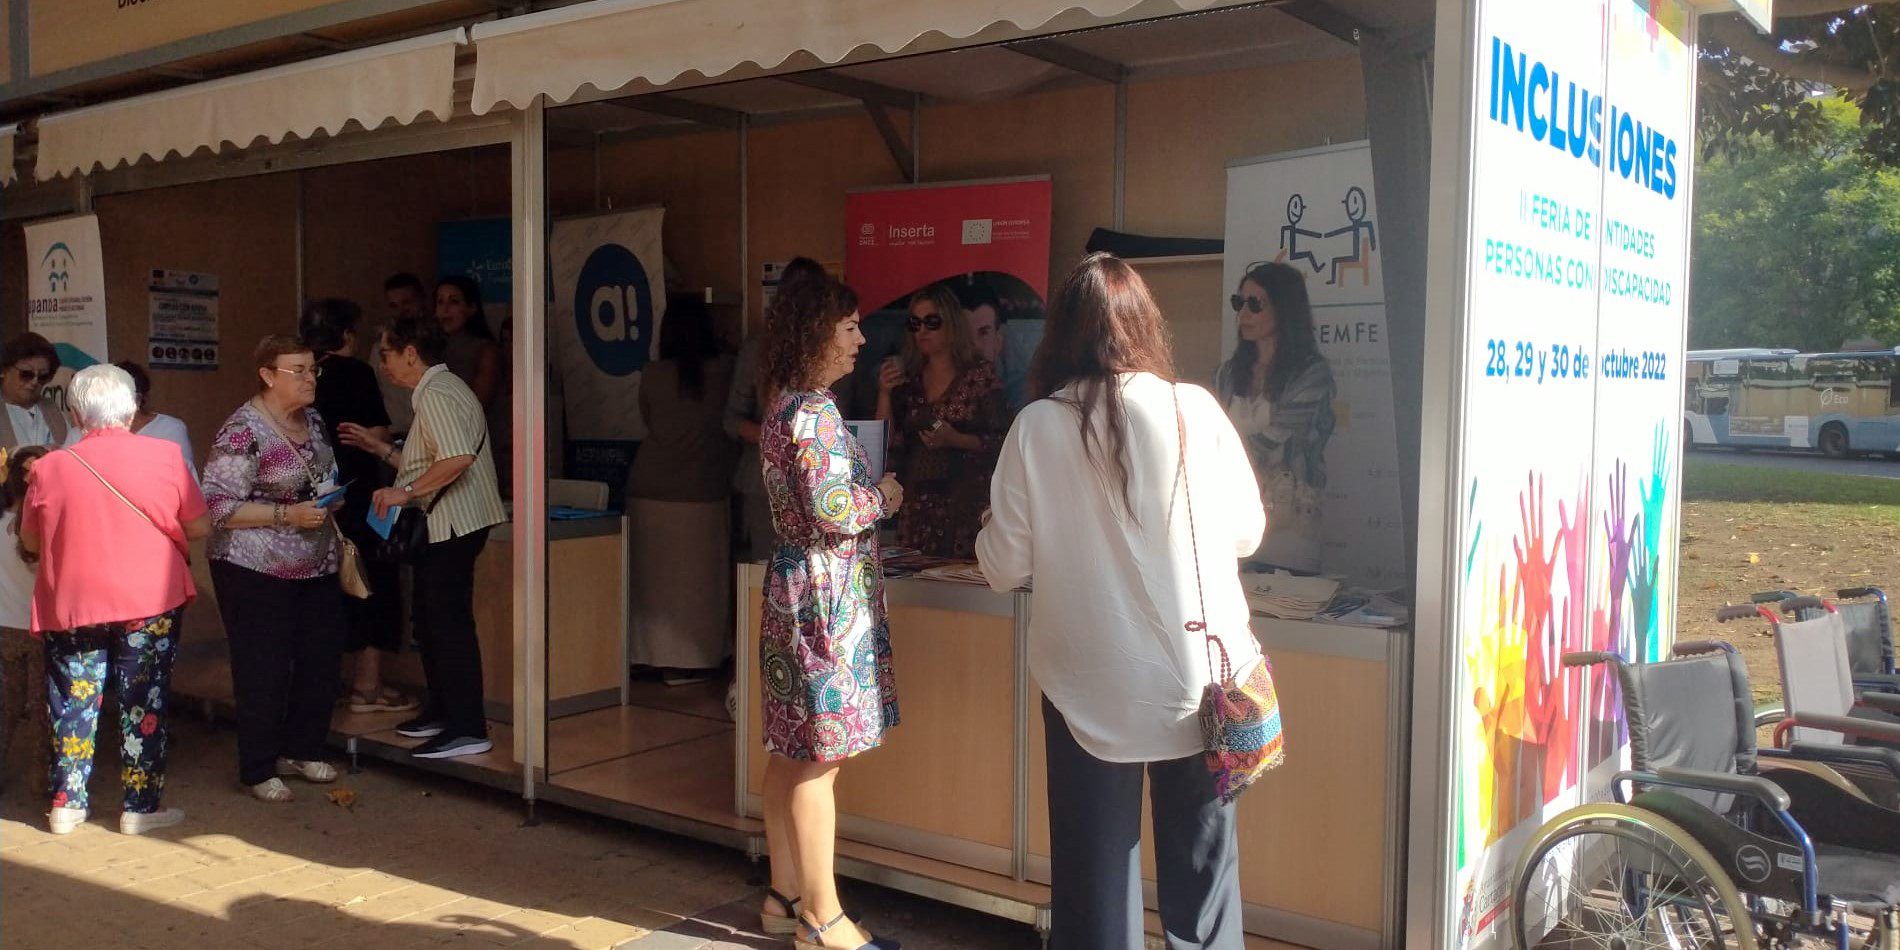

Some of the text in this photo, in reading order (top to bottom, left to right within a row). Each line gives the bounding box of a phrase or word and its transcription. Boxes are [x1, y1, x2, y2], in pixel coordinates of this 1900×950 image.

[1490, 35, 1677, 201] INCLUSIONES
[888, 224, 936, 239] Inserta
[1532, 194, 1572, 234] FERIA
[1574, 208, 1592, 241] DE
[1485, 237, 1563, 286] PERSONAS
[1566, 256, 1593, 292] CON
[590, 285, 640, 342] a!
[1311, 322, 1379, 344] EMFE
[1485, 338, 1510, 384] 28,
[1514, 340, 1534, 378] 29
[1537, 350, 1547, 386] y
[1550, 343, 1570, 379] 30
[1572, 344, 1590, 380] de
[1641, 350, 1666, 381] 2022
[1833, 394, 1849, 404] Eco
